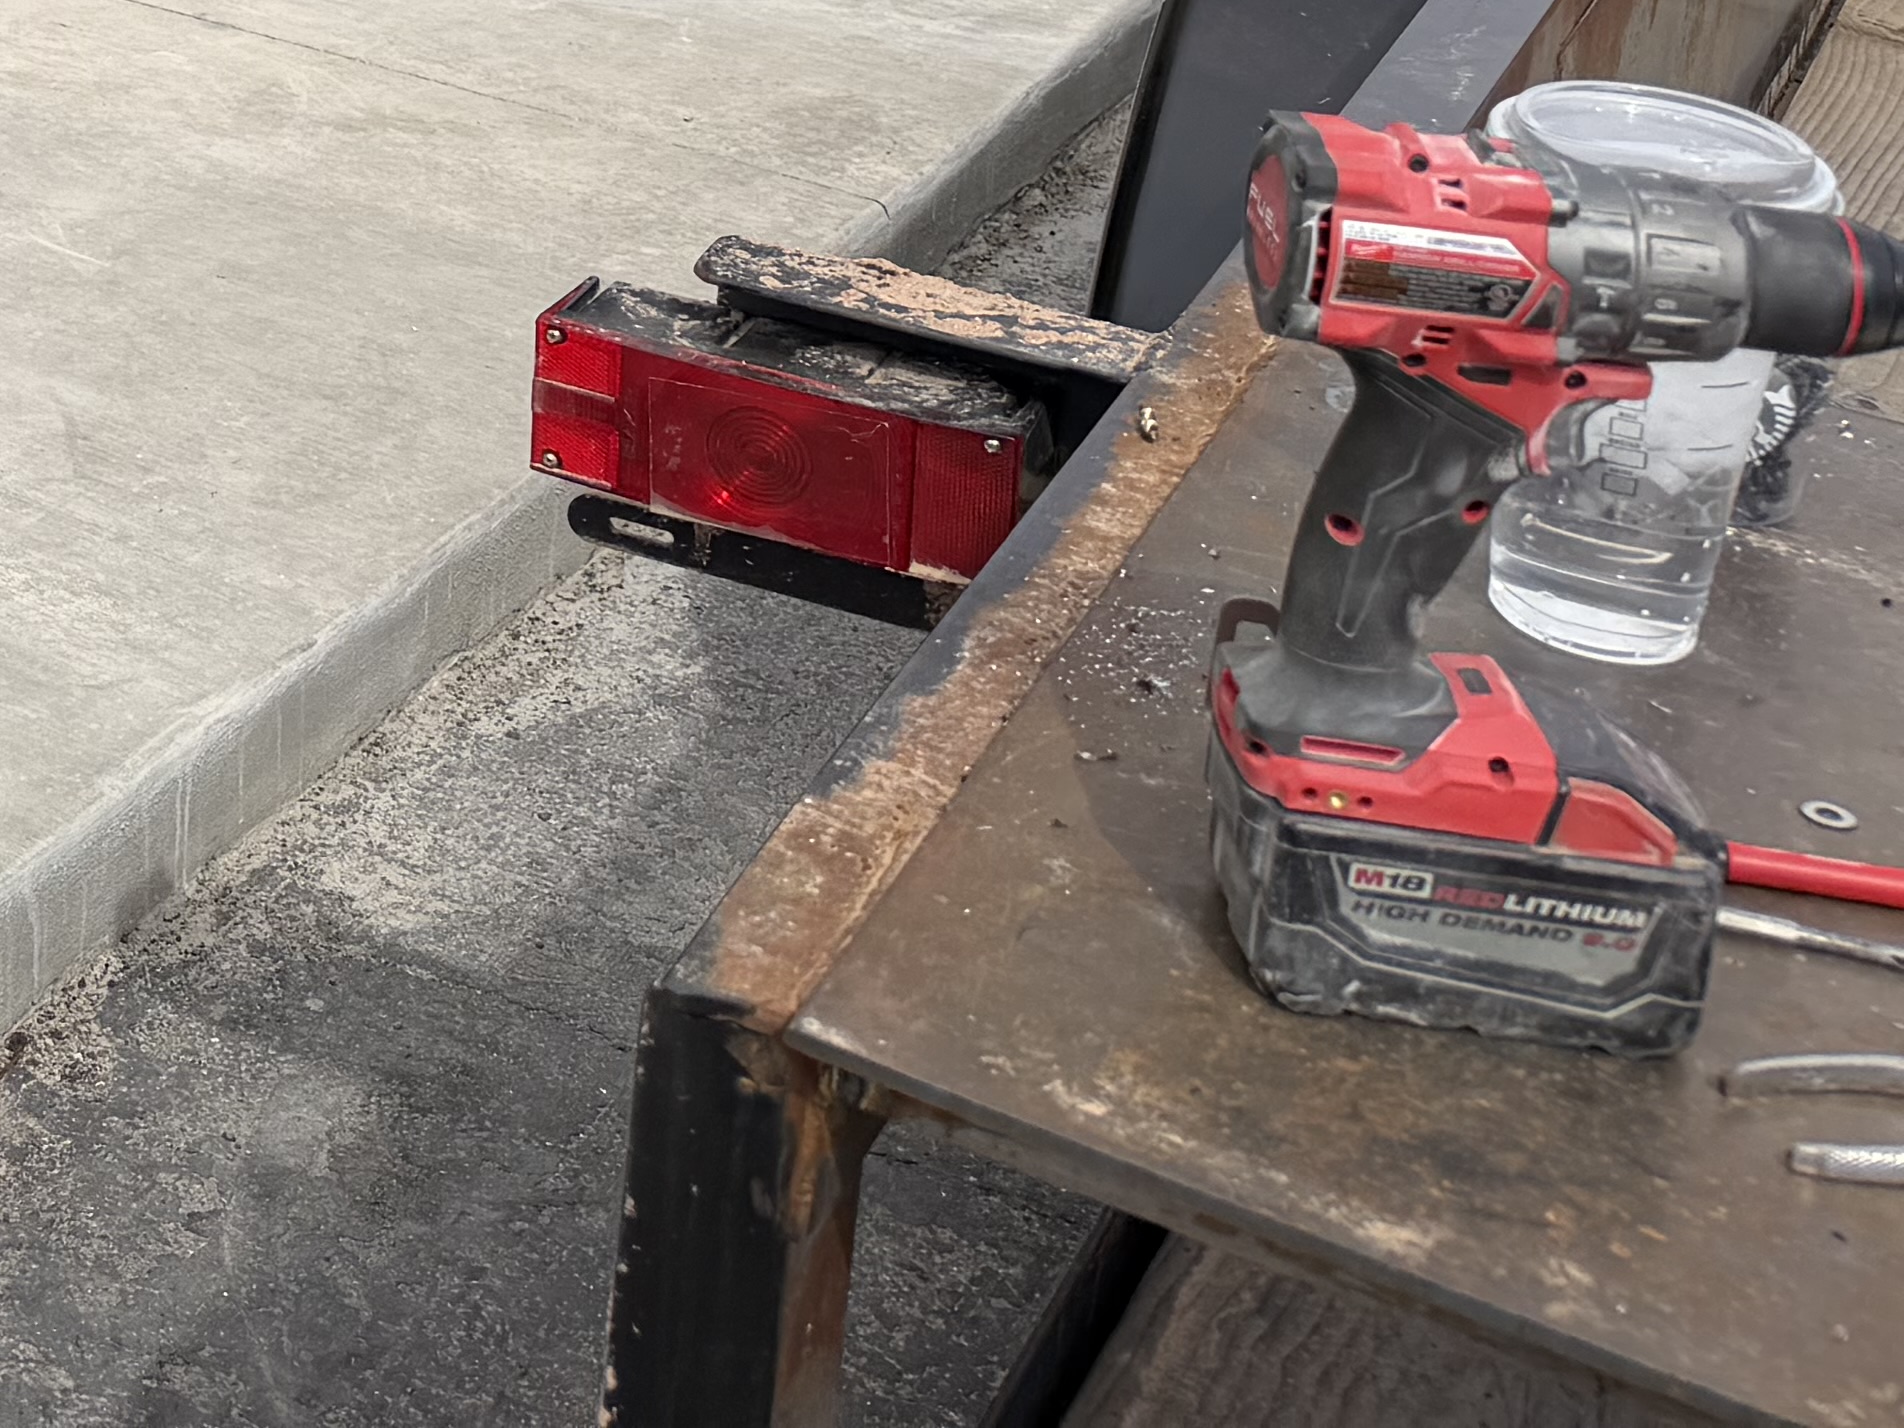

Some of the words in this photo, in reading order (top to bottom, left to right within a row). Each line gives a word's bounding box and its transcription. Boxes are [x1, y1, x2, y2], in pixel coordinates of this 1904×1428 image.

[1248, 181, 1281, 243] FUEL
[1353, 867, 1427, 892] M18
[1351, 899, 1431, 924] HIGH
[1438, 912, 1574, 943] DEMAND
